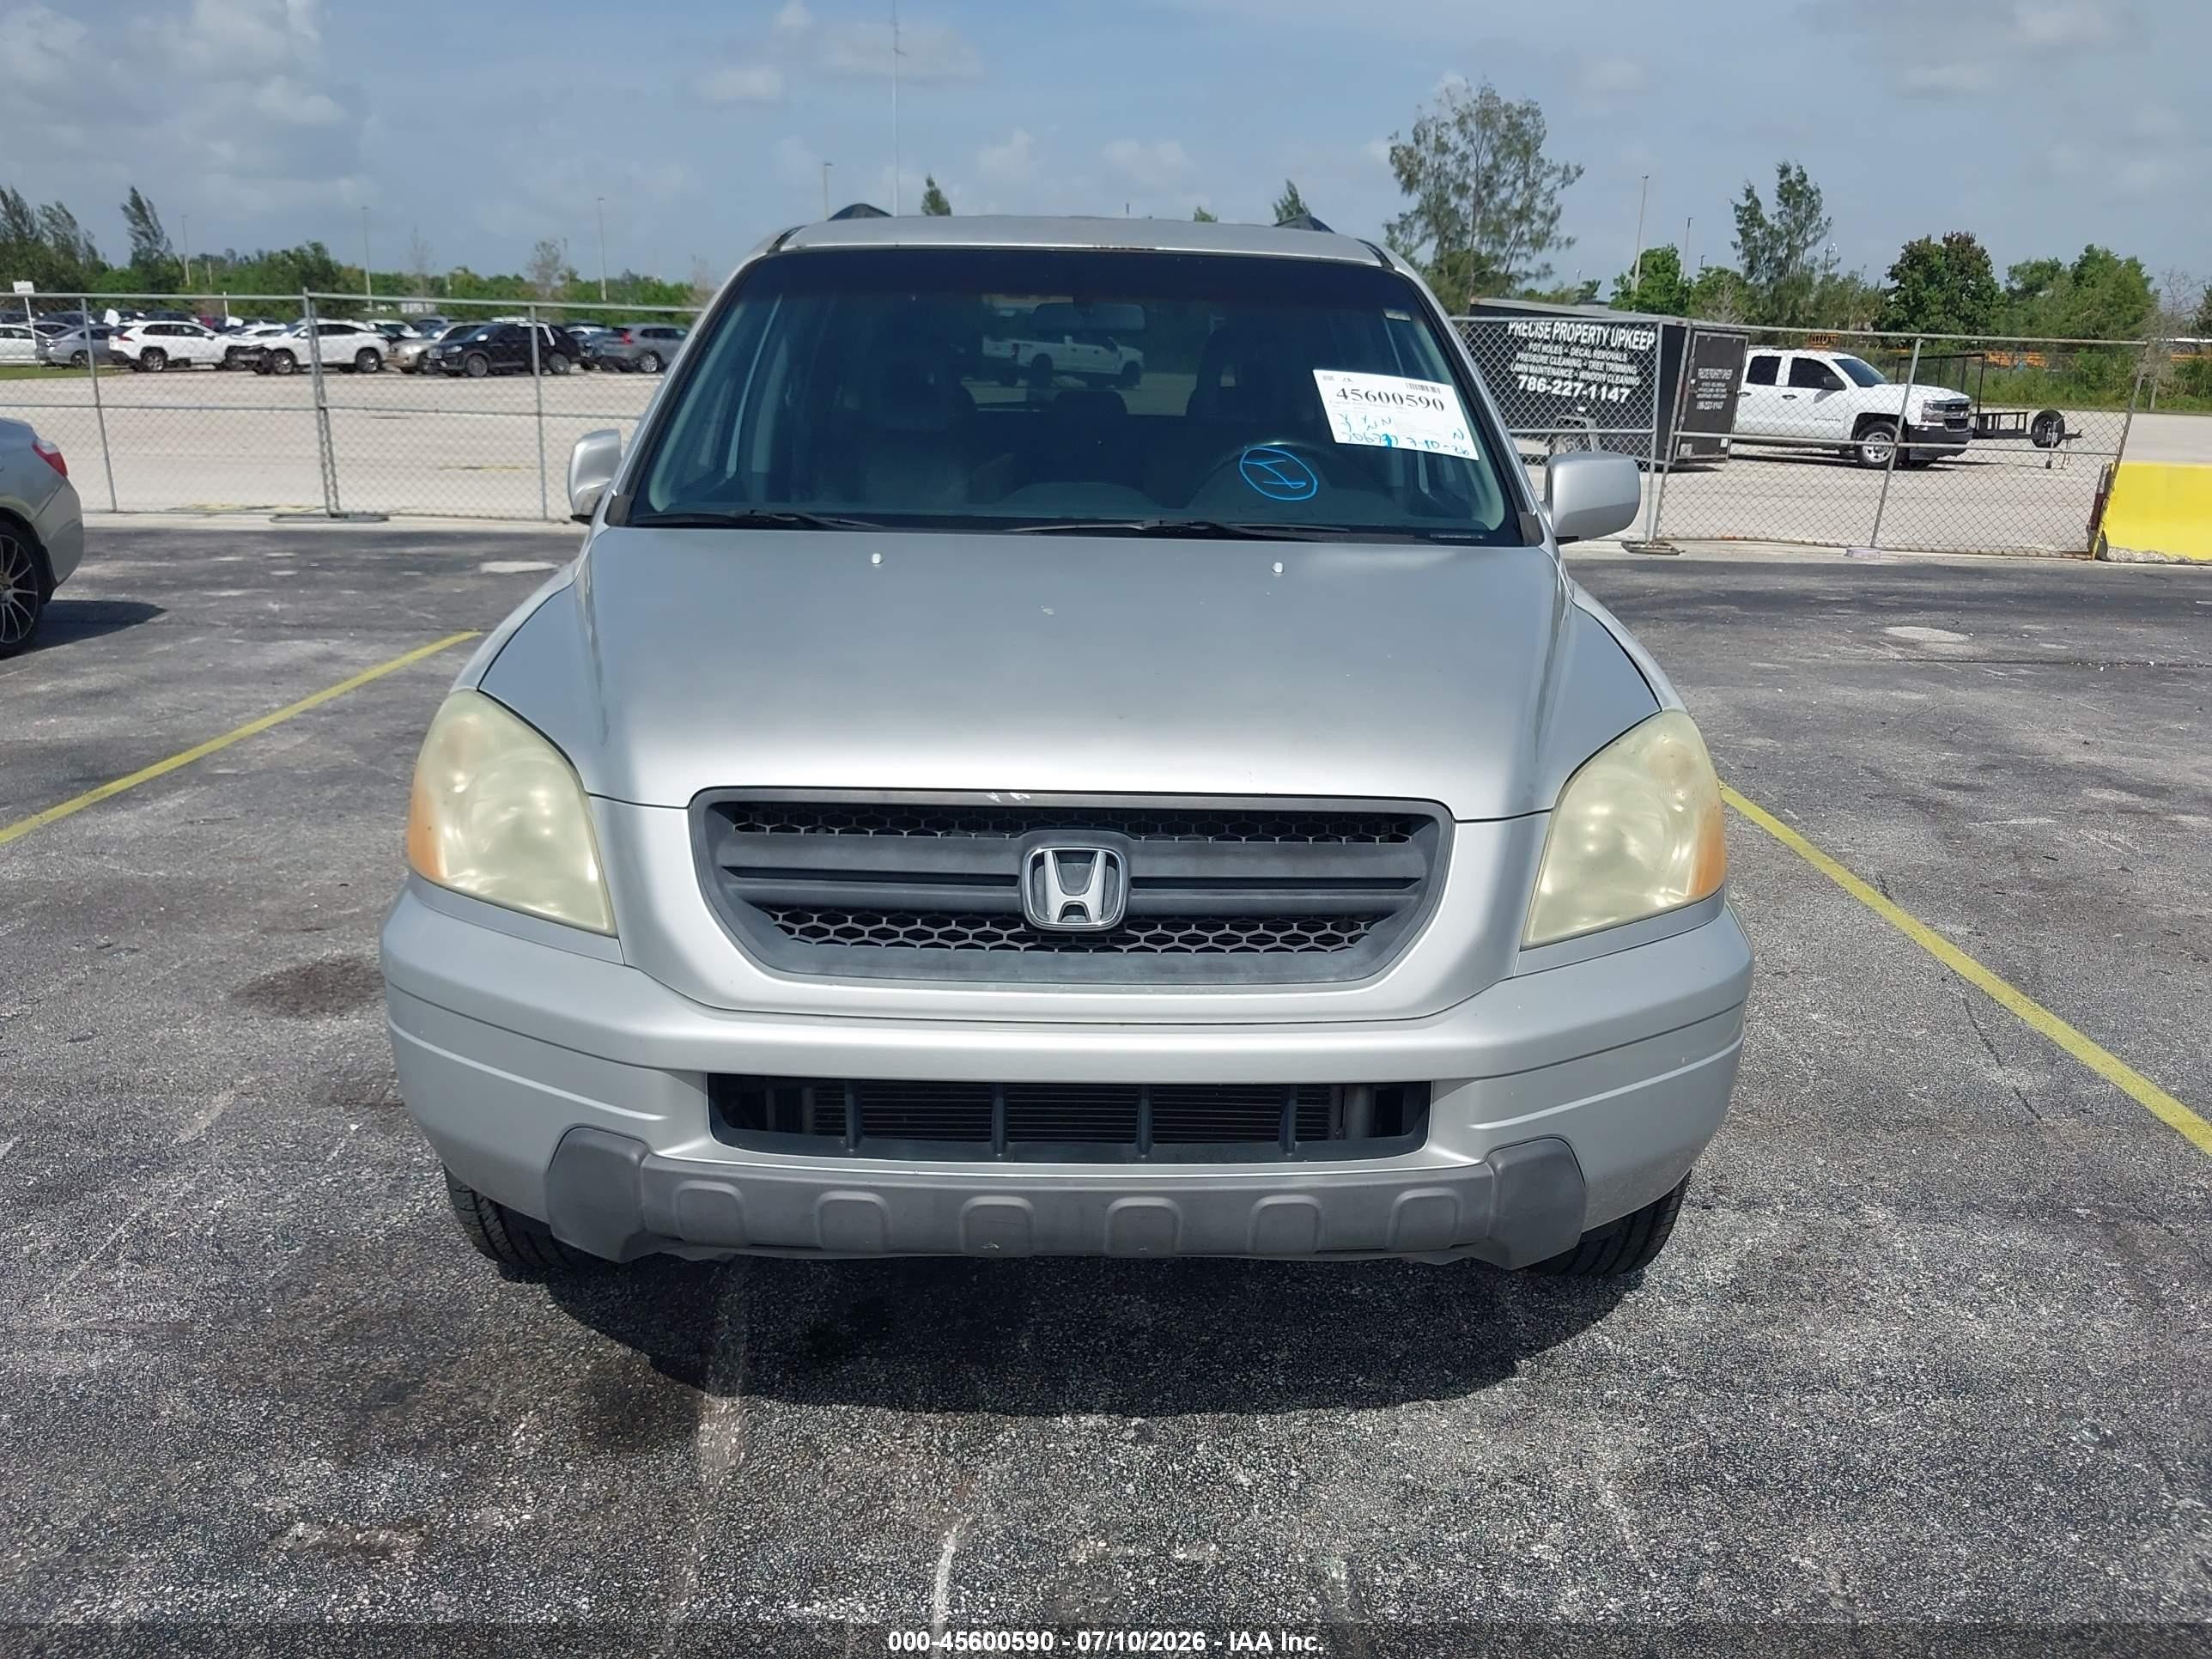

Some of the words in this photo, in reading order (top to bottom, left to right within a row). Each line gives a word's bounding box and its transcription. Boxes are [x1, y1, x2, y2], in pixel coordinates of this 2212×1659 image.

[1508, 322, 1552, 339] PRECISE
[1553, 323, 1610, 345] PROPERTY
[1611, 328, 1656, 350] UPKEEP
[1570, 347, 1592, 357] DECAL
[1593, 349, 1628, 362] REMOVALS
[1529, 364, 1573, 378] MAINTENANCE
[1607, 373, 1640, 386] CLEANING
[1589, 361, 1605, 371] TREE
[1606, 362, 1637, 374] TRIMMING
[1336, 387, 1444, 412] 45600590
[1516, 374, 1631, 404] 786-227-1147
